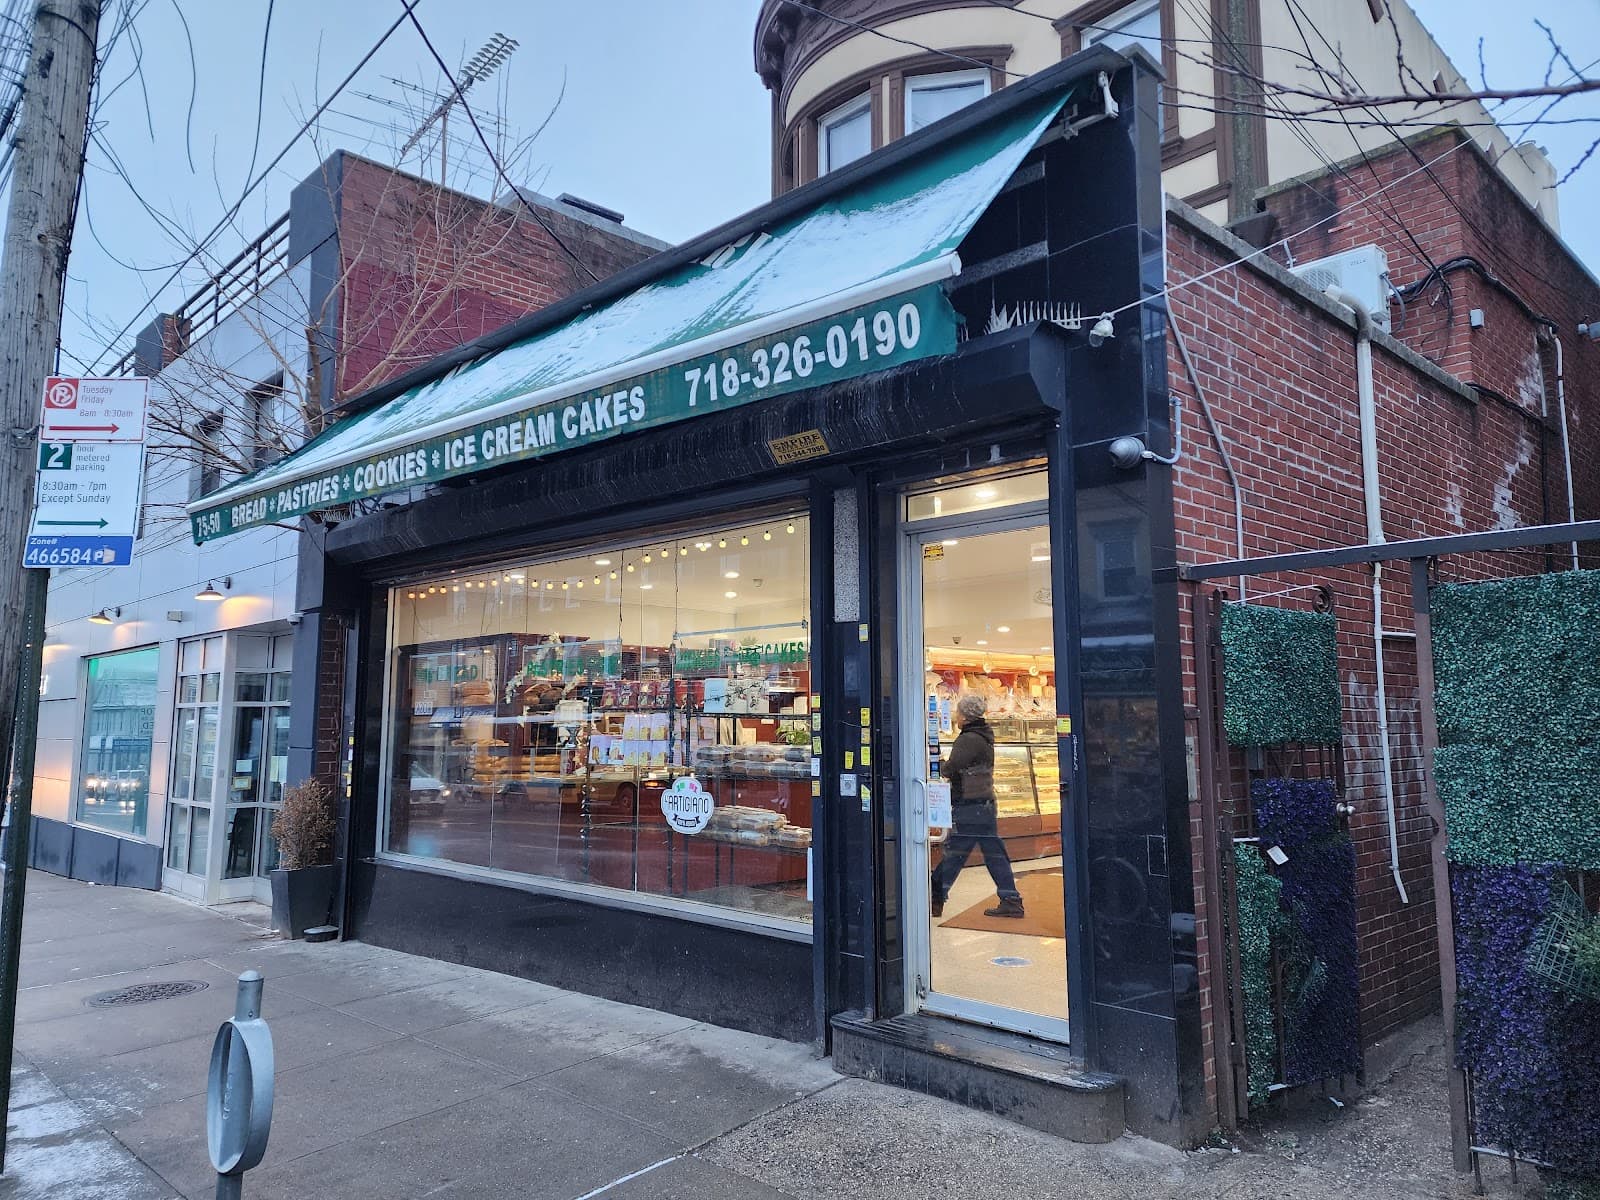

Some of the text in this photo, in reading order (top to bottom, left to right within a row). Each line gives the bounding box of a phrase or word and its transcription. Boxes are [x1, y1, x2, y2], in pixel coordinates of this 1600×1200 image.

[82, 385, 113, 395] Tuesday
[81, 395, 105, 405] Friday
[79, 408, 97, 417] 8am
[196, 303, 921, 537] 75-50 BREAD PASTRIES COOKIES ICE CREAM CAKES 718-326-0190
[773, 433, 821, 451] EMPIRE
[47, 443, 65, 468] 2
[76, 454, 110, 462] metered
[75, 462, 105, 472] parking
[42, 481, 78, 491] 8:30am
[88, 481, 107, 492] 7pm
[41, 493, 111, 504] Except Sunday
[30, 537, 58, 545] Zone#
[27, 547, 92, 564] 466584
[765, 641, 804, 664] CAKES
